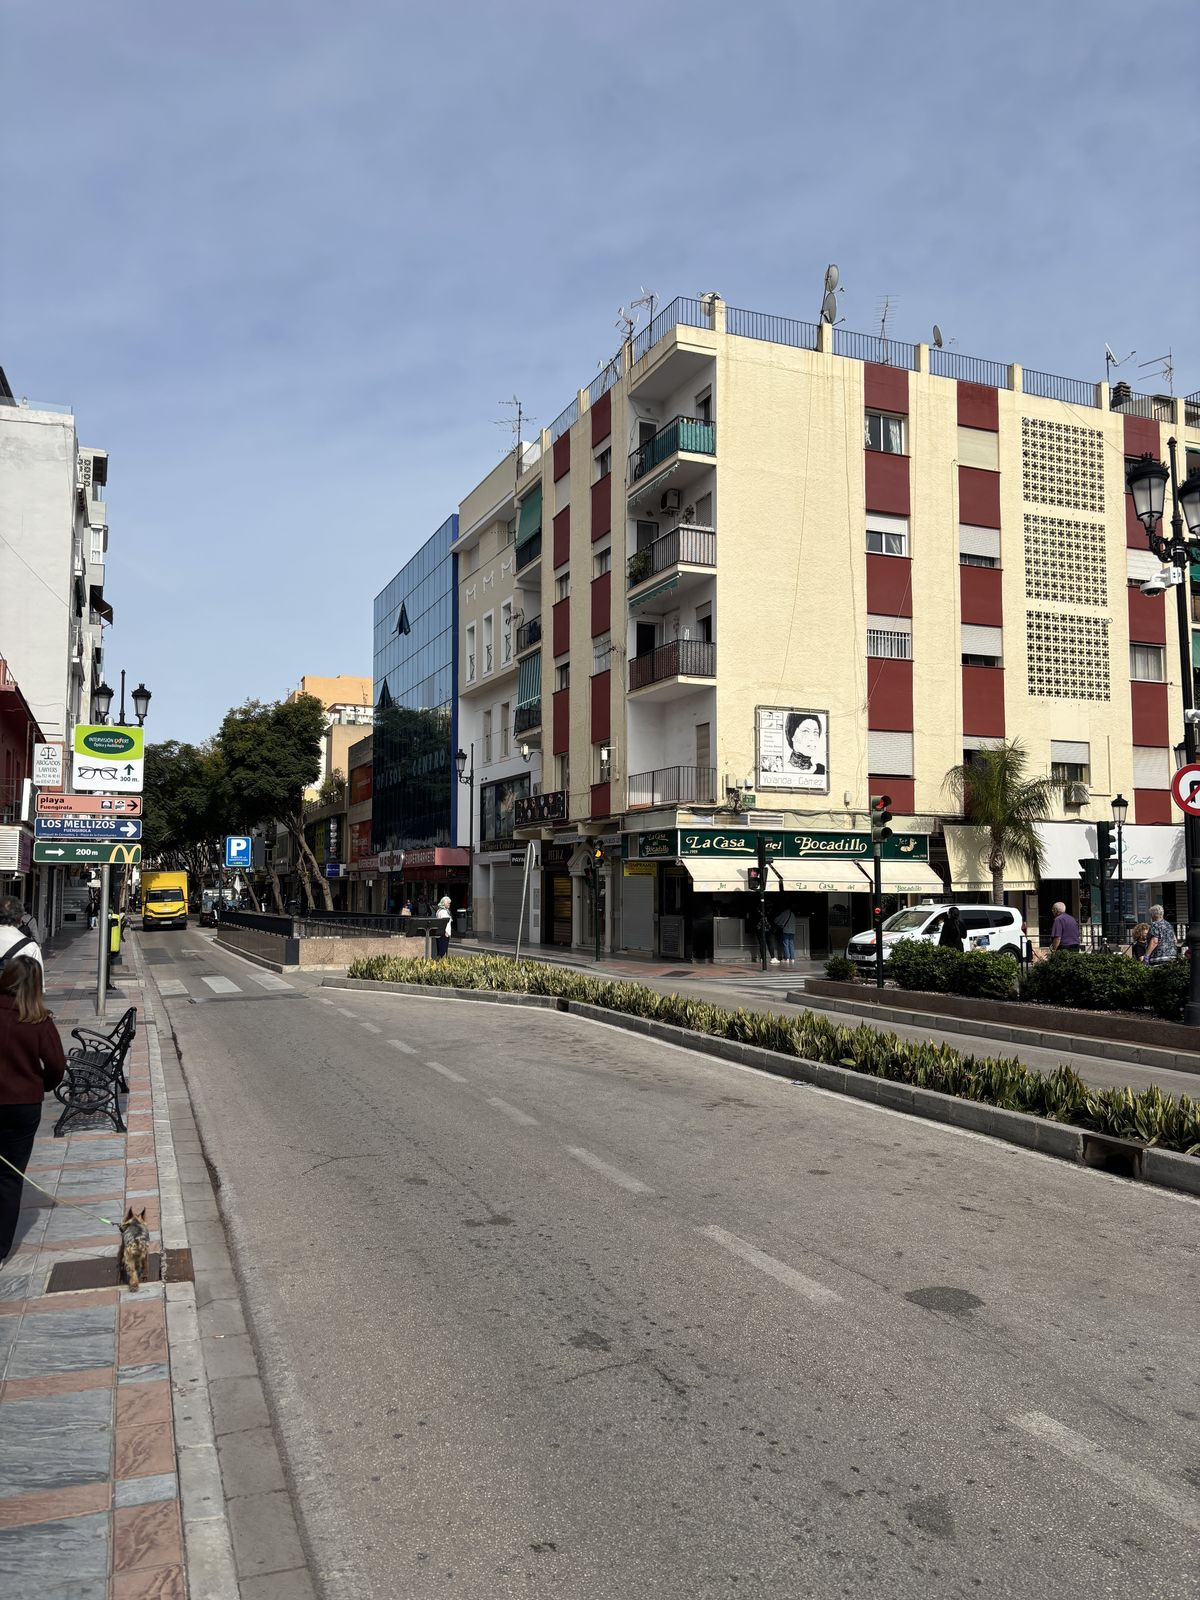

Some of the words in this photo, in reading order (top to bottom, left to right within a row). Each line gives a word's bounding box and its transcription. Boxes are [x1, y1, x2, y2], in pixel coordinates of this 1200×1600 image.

[412, 748, 445, 776] CENTRO
[762, 775, 792, 784] Yolanda
[40, 796, 65, 804] playa
[41, 819, 62, 828] LOS
[63, 820, 116, 829] MELLIZOS
[230, 839, 247, 856] P
[685, 836, 711, 849] La
[713, 836, 755, 853] Casa
[765, 841, 782, 850] del
[794, 836, 867, 856] Bocadillo
[819, 882, 838, 891] Casa
